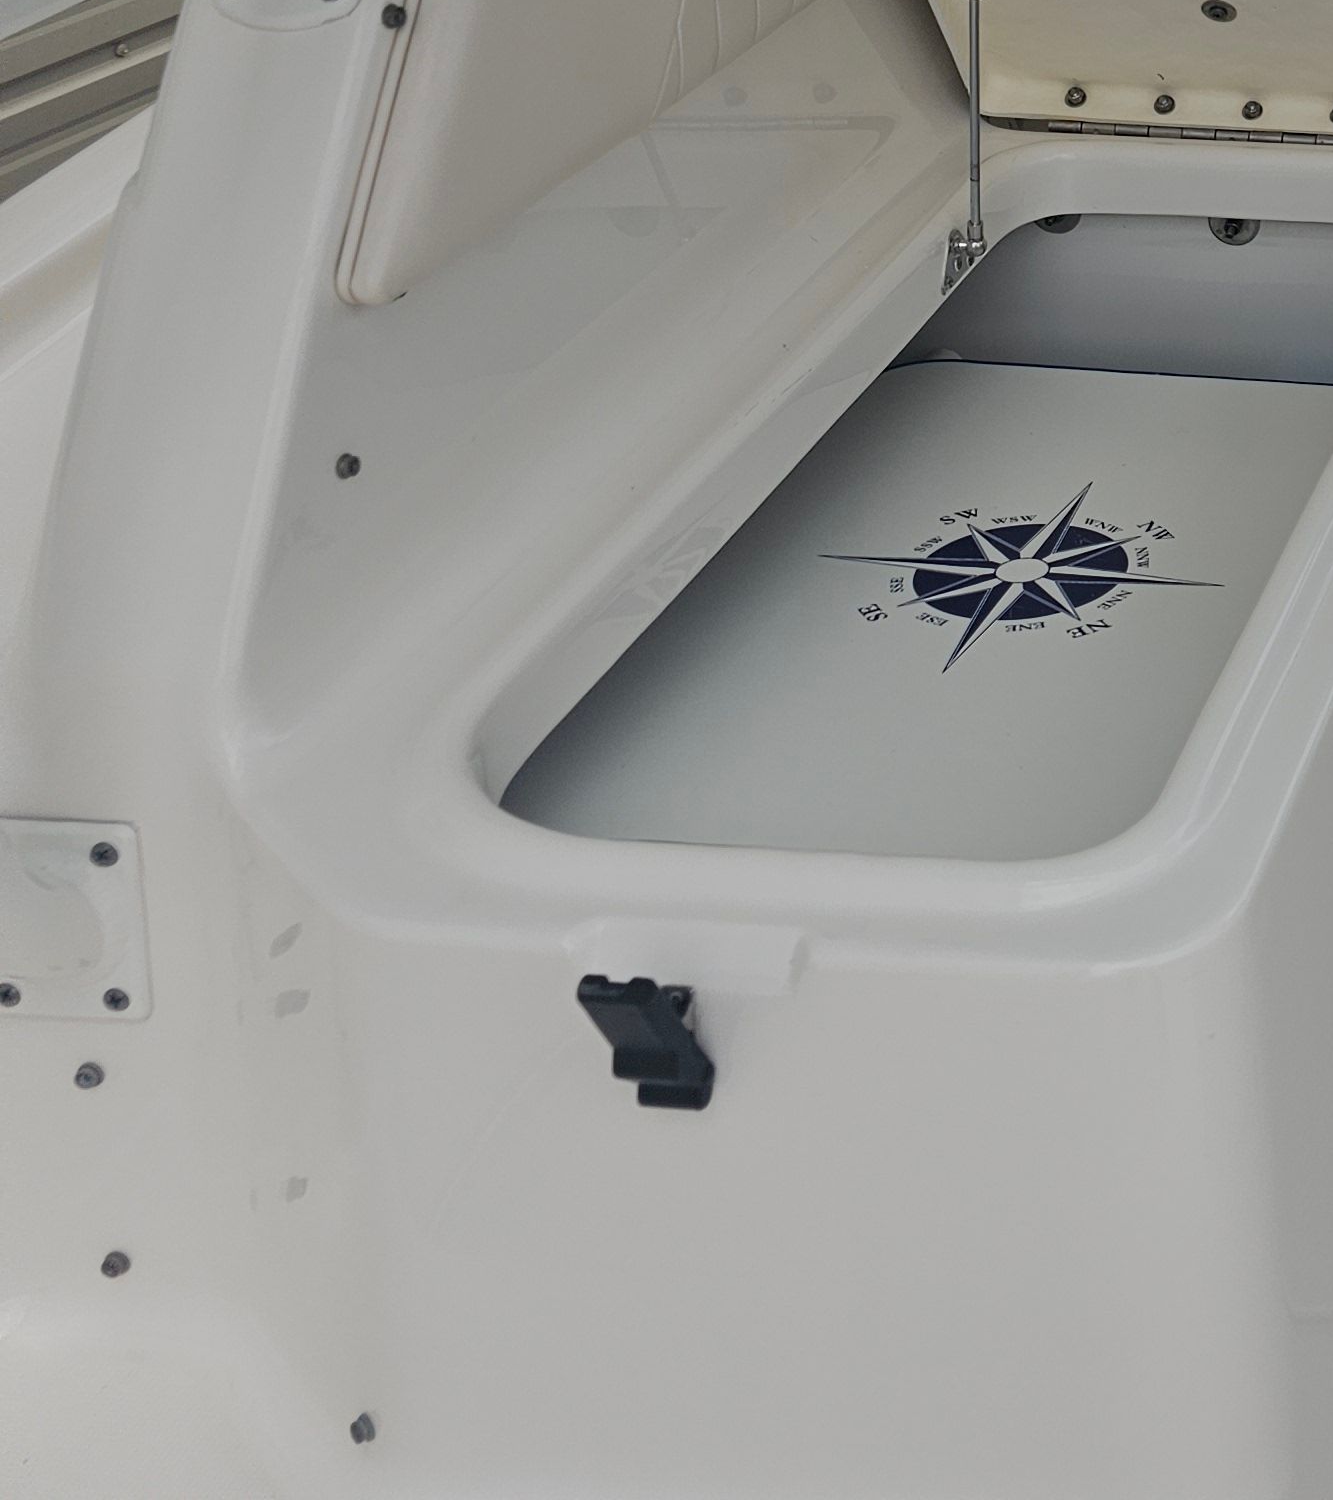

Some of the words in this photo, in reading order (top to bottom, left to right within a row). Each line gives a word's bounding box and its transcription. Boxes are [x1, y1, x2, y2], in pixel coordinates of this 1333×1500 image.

[940, 508, 978, 525] SW
[991, 514, 1038, 524] WSW
[1084, 517, 1124, 534] WNW
[1136, 519, 1176, 541] NW
[914, 536, 943, 553] SSW
[1097, 589, 1133, 611] NNE
[857, 603, 888, 622] SE
[1066, 619, 1113, 638] NE
